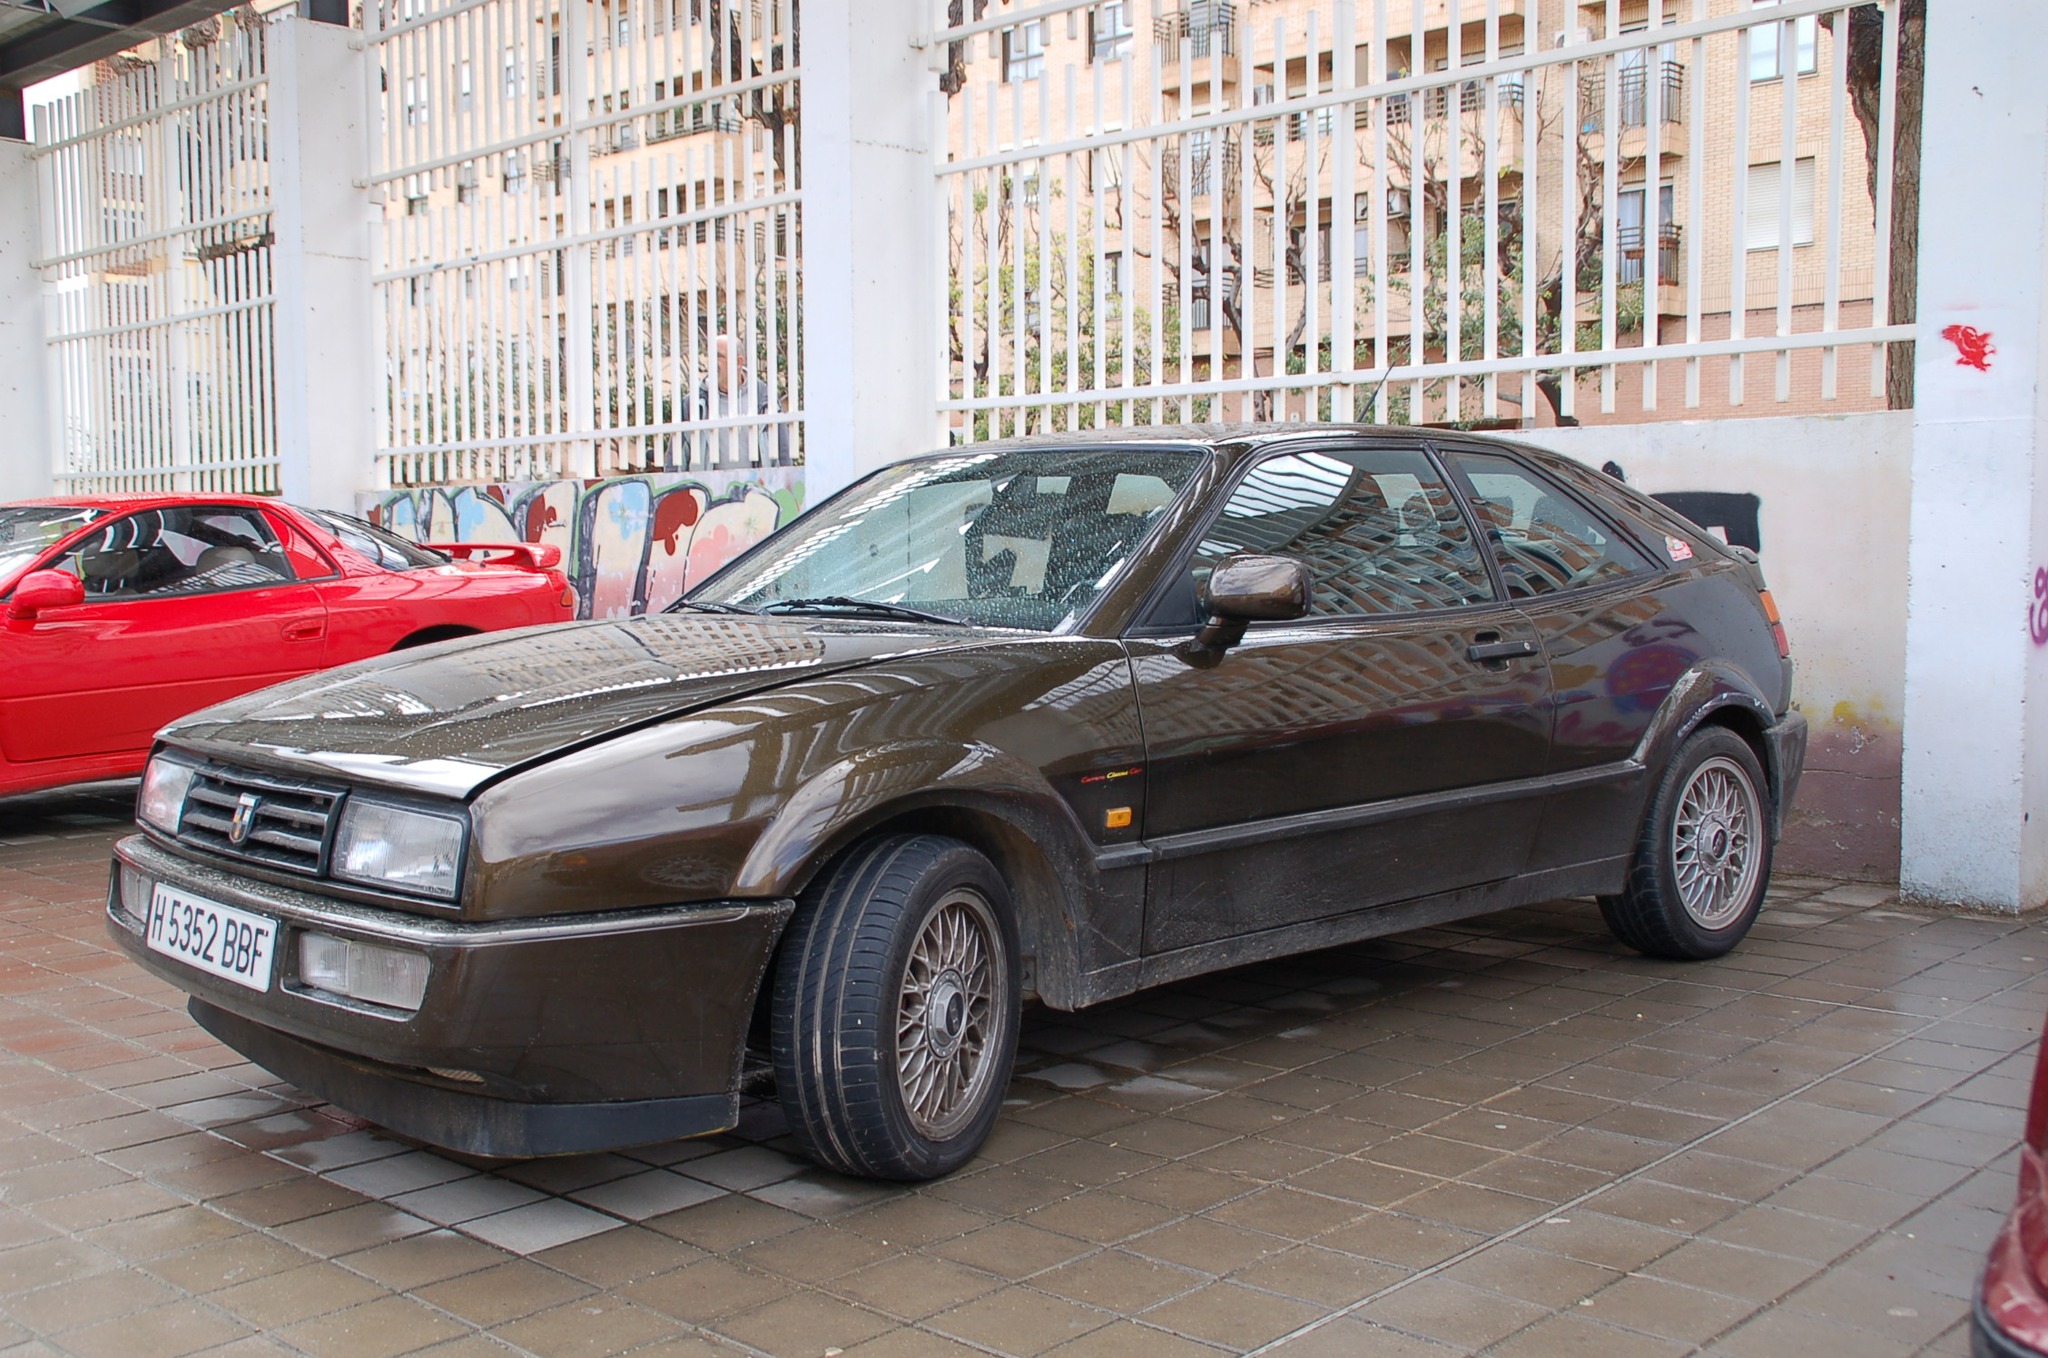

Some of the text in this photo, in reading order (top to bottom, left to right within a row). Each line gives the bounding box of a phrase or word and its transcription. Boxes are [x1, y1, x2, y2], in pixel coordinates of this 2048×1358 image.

[152, 894, 269, 977] H 5352 BBF
